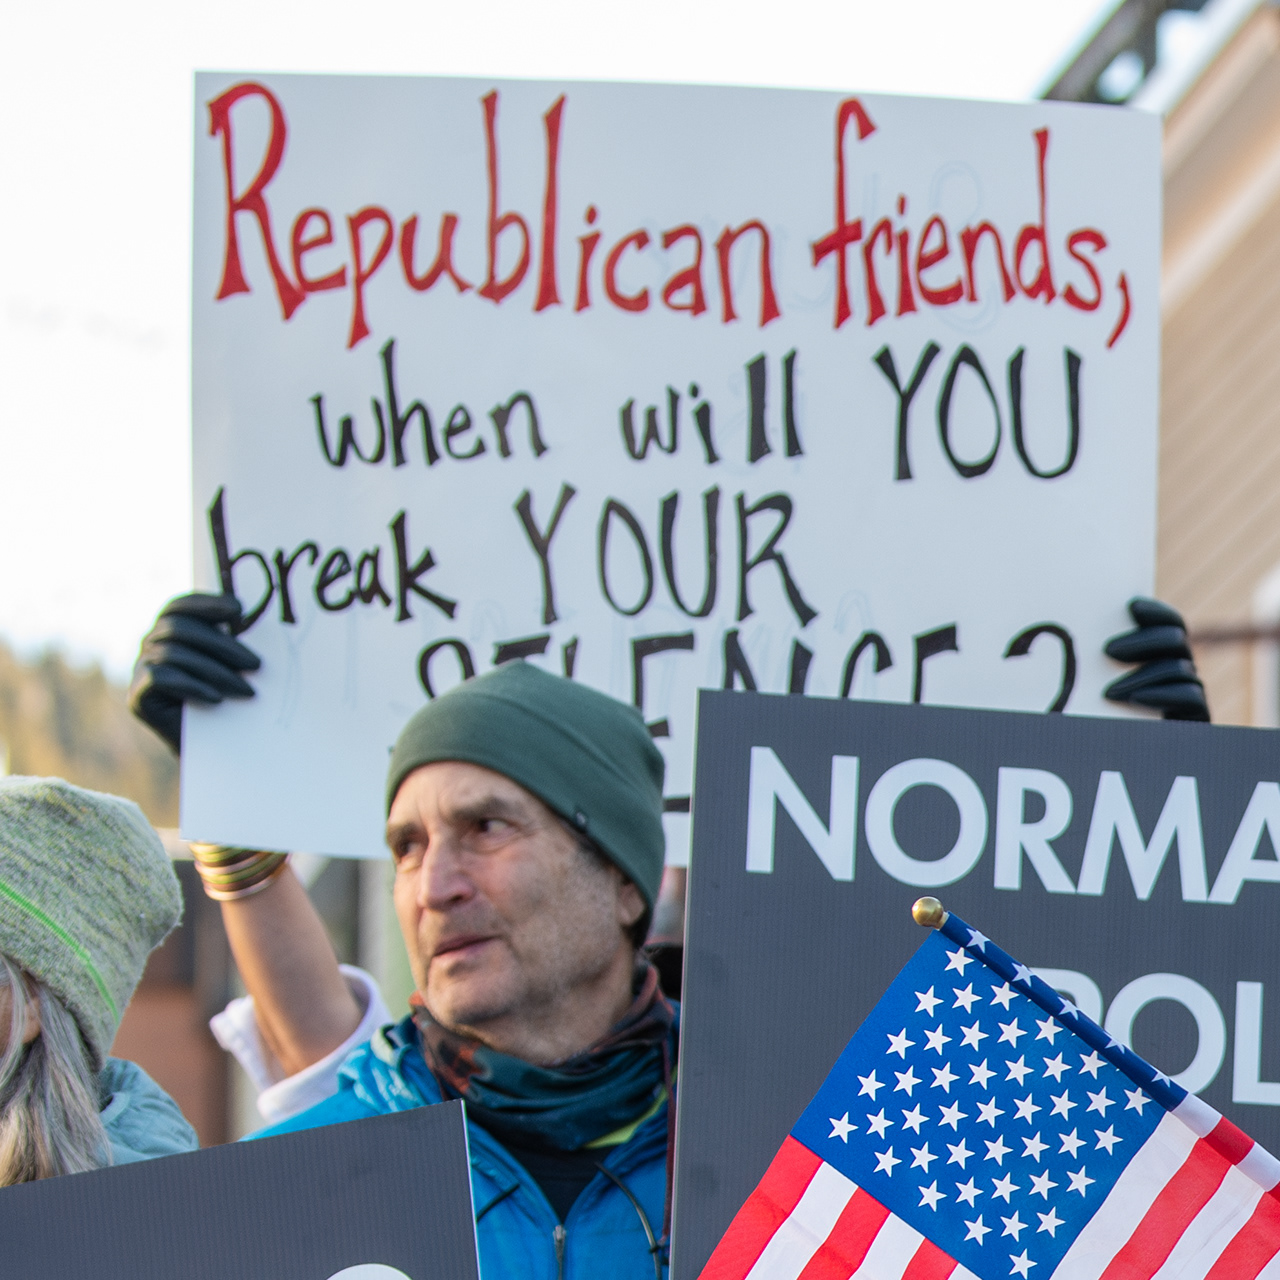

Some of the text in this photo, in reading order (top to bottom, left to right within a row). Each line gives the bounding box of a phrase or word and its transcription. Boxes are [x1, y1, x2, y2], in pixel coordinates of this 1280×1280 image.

[209, 82, 1132, 348] Republican friends,
[310, 337, 1083, 481] when will YOU
[206, 482, 818, 637] break YOUR
